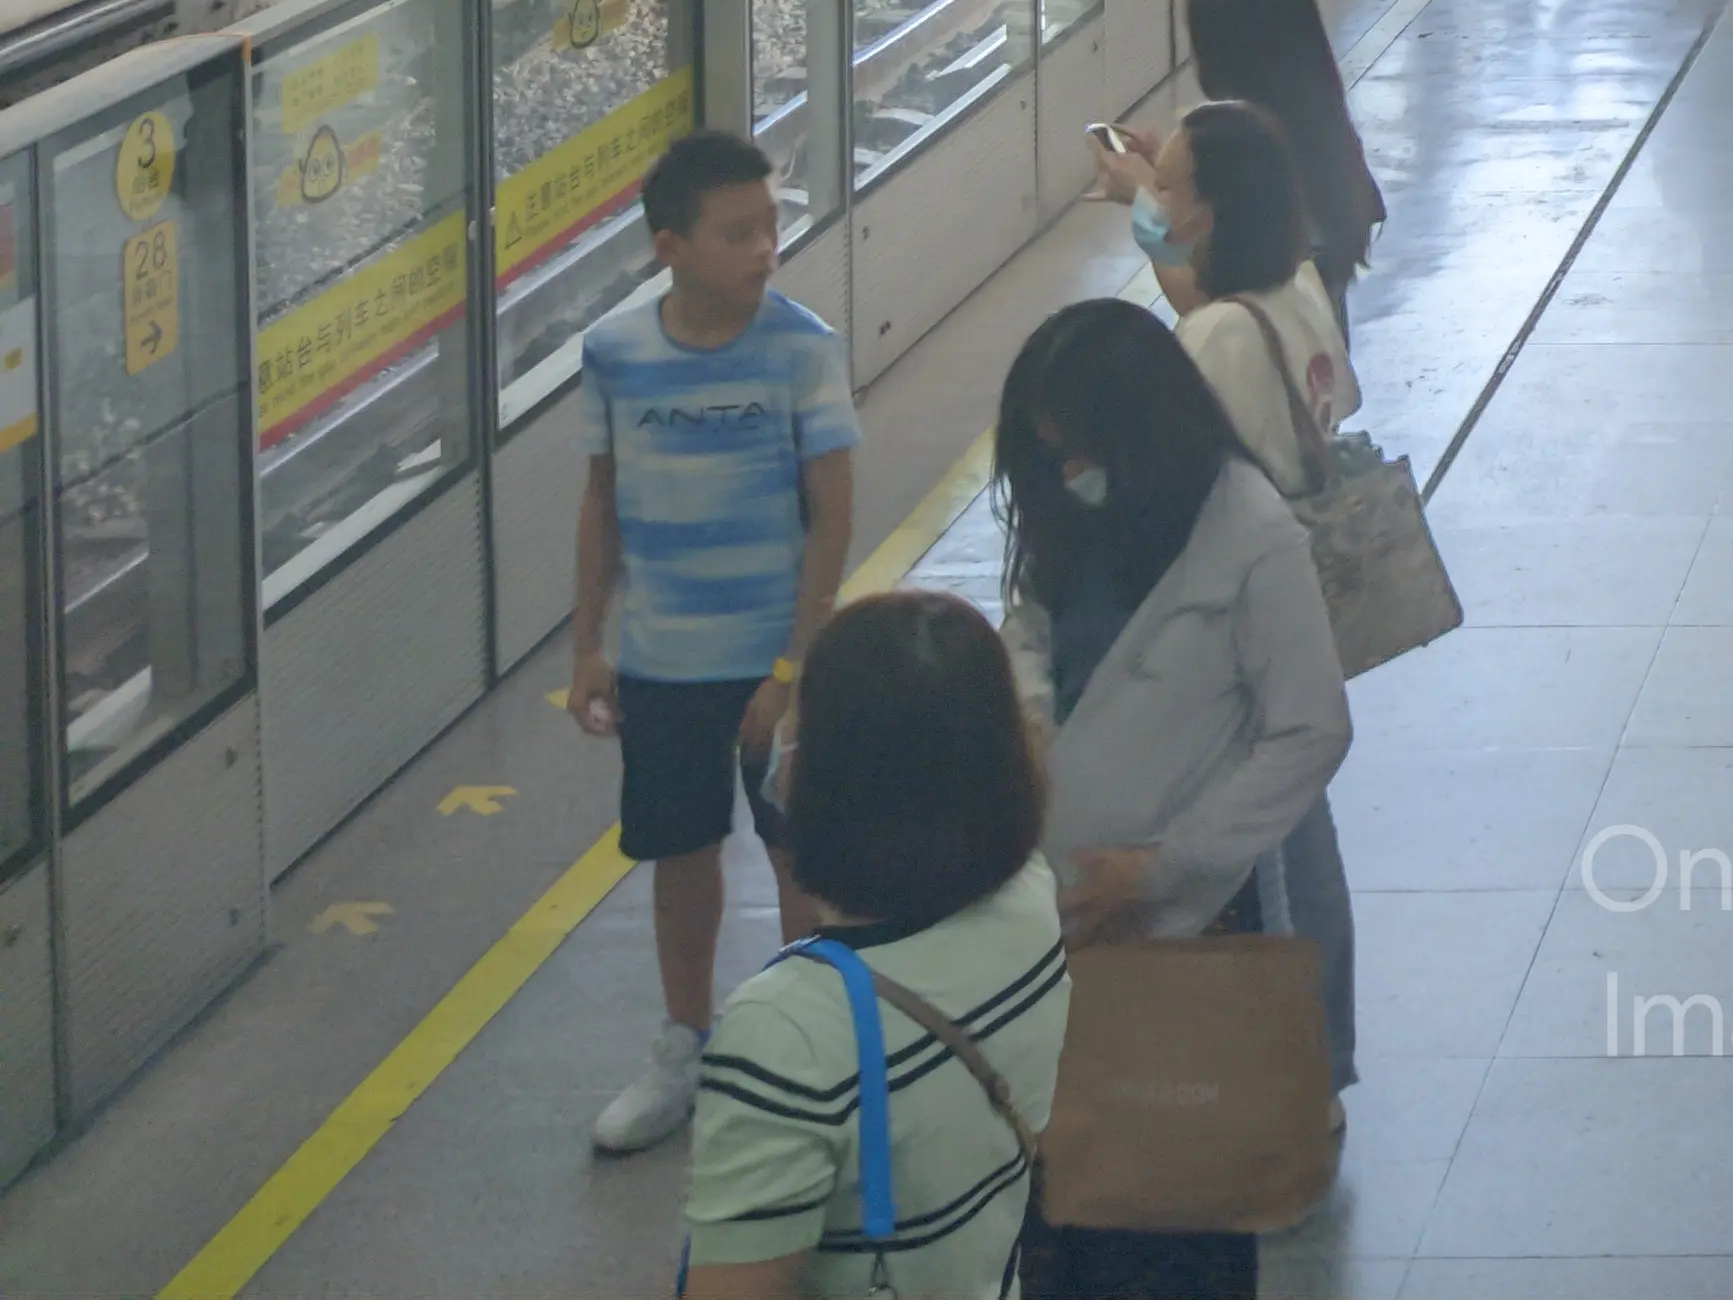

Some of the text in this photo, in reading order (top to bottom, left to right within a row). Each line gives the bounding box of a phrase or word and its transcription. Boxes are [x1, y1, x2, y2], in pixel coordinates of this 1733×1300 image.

[137, 116, 157, 170] 3
[134, 231, 168, 282] 28
[637, 401, 766, 430] ANTA
